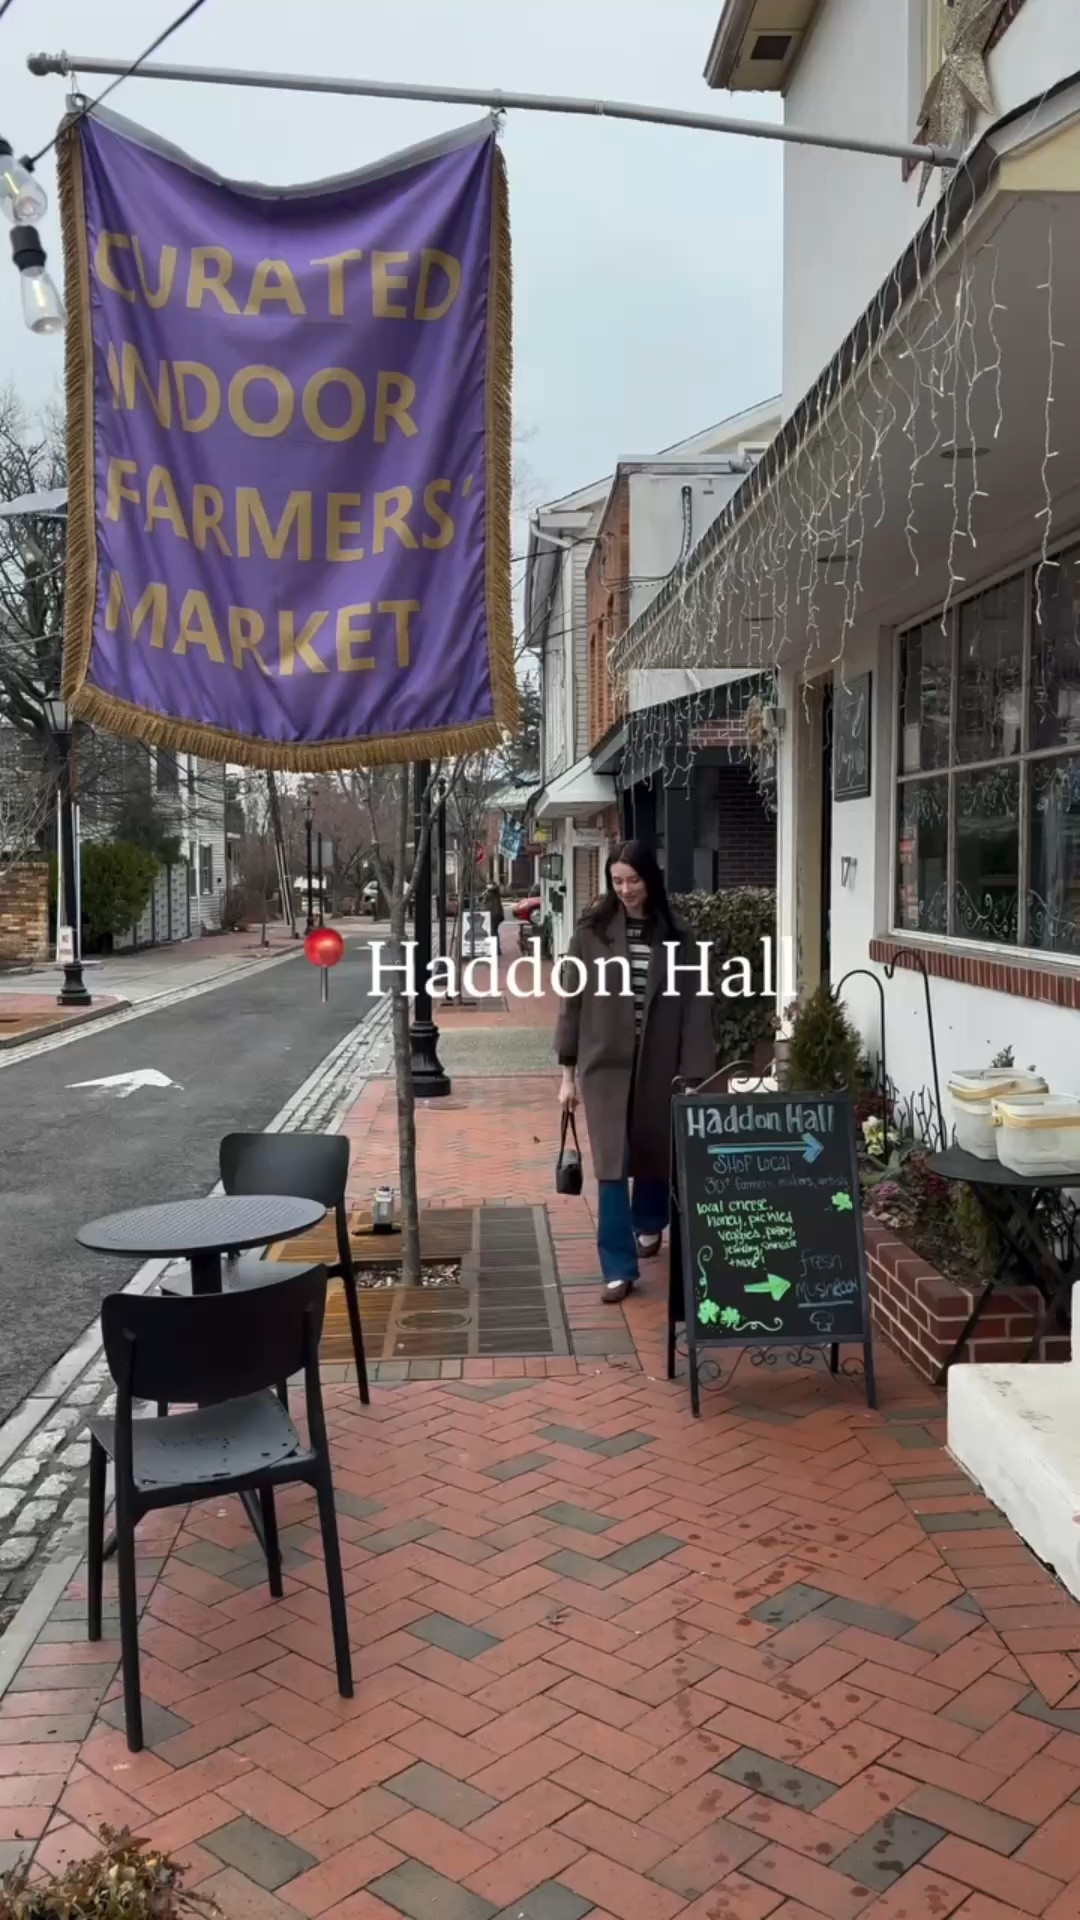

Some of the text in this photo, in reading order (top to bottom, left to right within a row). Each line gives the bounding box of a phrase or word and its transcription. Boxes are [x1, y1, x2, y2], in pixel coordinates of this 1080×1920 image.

[94, 229, 461, 321] CURATED
[108, 341, 419, 443] INDOOR
[105, 456, 474, 562] FARMERS'
[104, 569, 420, 676] MARKET
[686, 1104, 834, 1138] Haddon Hall
[696, 1200, 724, 1215] local
